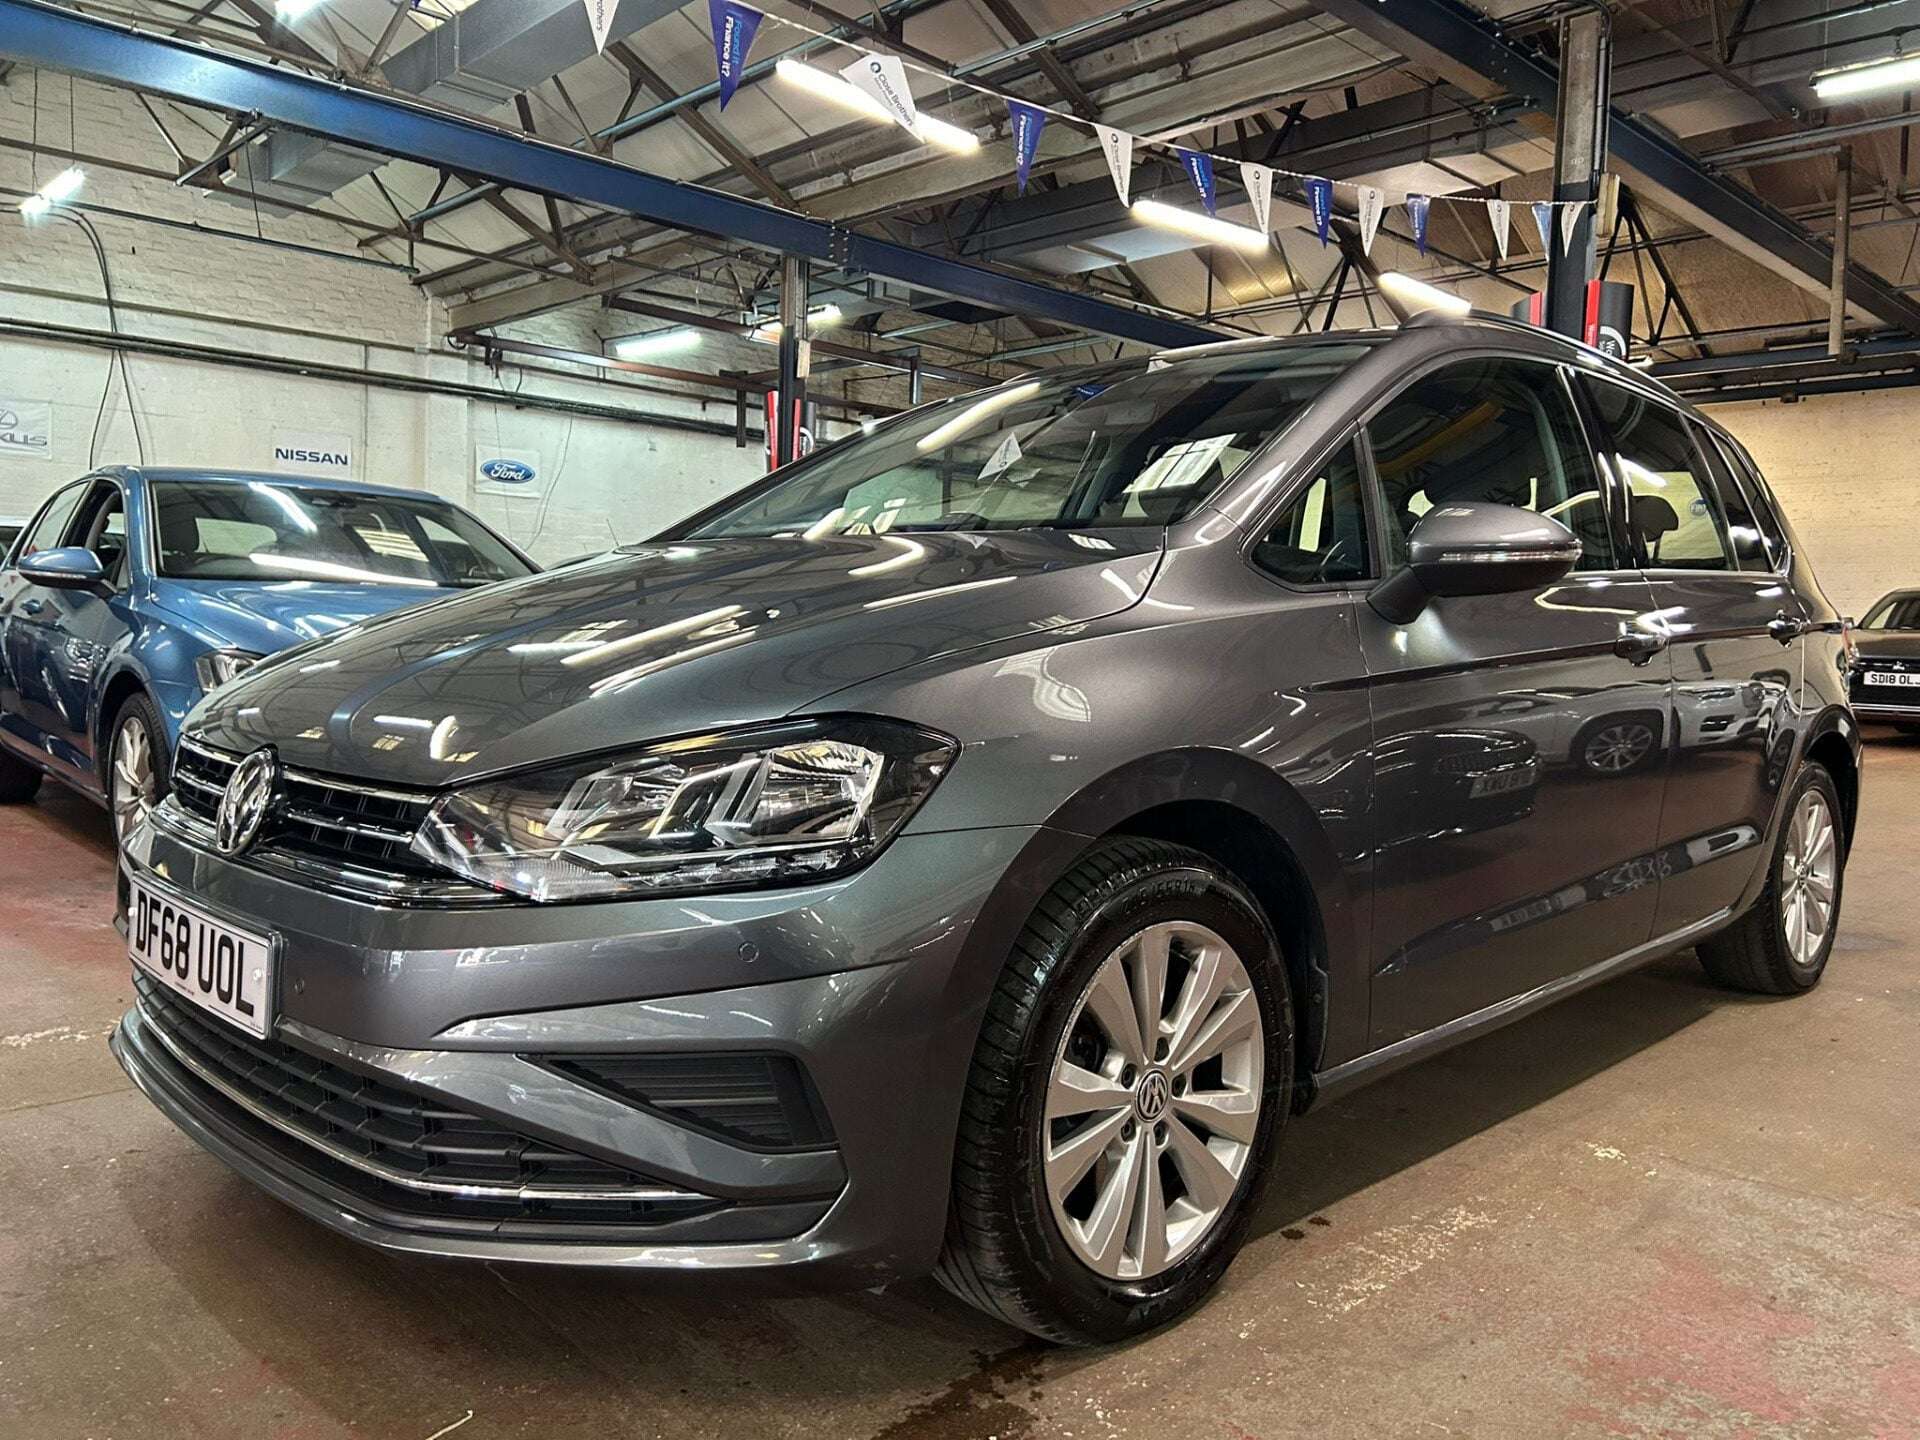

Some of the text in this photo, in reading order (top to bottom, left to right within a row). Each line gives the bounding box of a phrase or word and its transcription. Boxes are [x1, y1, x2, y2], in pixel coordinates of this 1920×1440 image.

[721, 15, 734, 78] Finance it?
[733, 19, 742, 54] Found
[878, 73, 914, 126] Close Brothers
[1018, 114, 1027, 152] Finance
[1190, 157, 1202, 187] Finance
[275, 447, 348, 466] NISSAN
[490, 463, 526, 481] Ford
[1871, 673, 1920, 686] SD18 OL
[135, 888, 254, 1018] DF68 UOL
